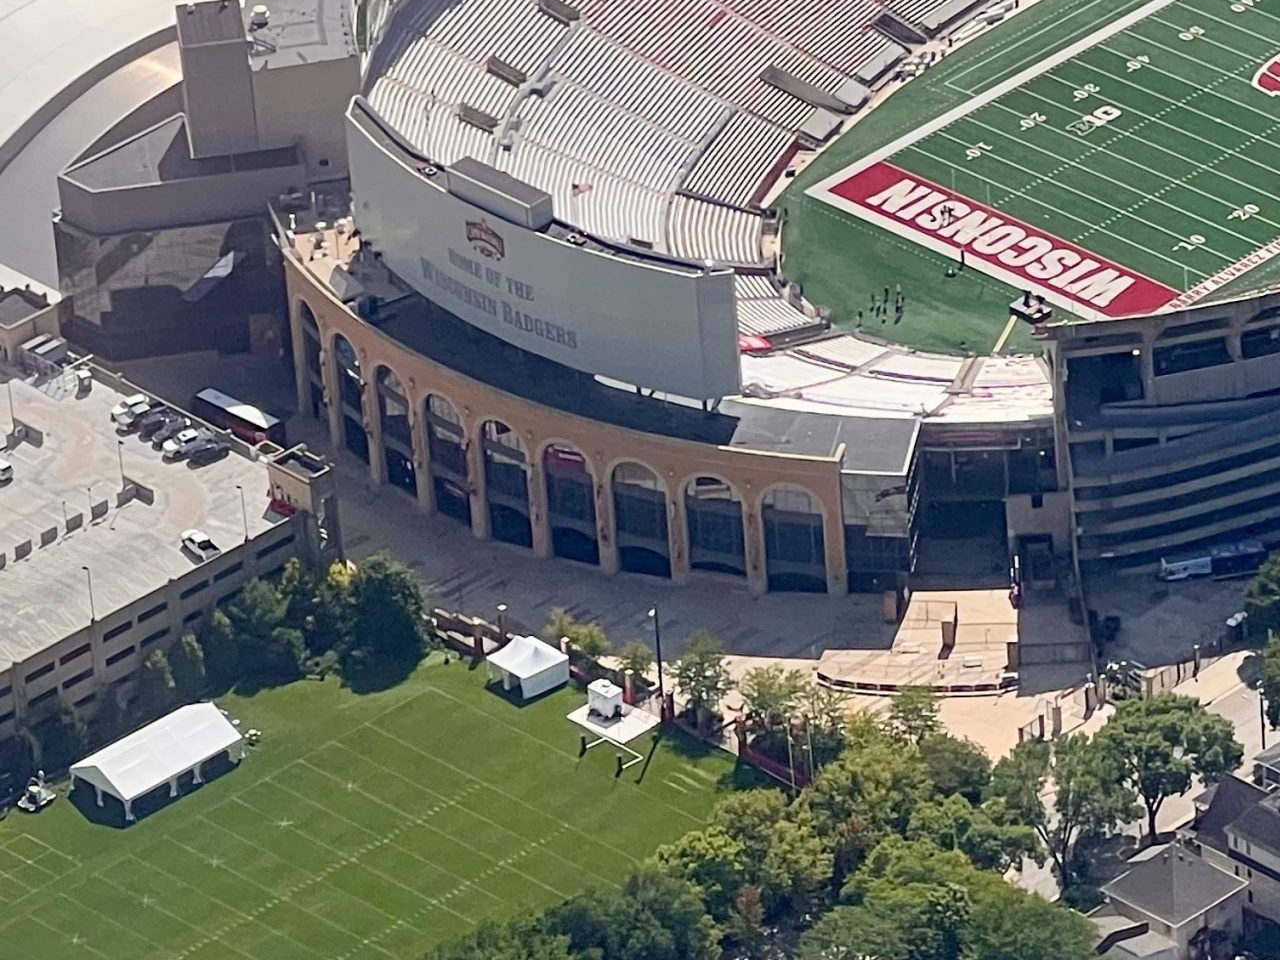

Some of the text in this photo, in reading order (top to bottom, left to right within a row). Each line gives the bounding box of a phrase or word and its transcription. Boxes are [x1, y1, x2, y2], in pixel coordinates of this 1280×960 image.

[1178, 25, 1205, 41] 50
[1075, 83, 1101, 100] 30
[1023, 112, 1047, 129] 20
[968, 141, 993, 158] 10
[1233, 204, 1260, 220] 20
[865, 178, 1136, 308] WISCONSIN
[1180, 234, 1206, 251] 10
[485, 268, 501, 289] OF
[505, 276, 535, 302] THE
[1169, 280, 1210, 310] BARRY
[1212, 253, 1265, 288] ALVAREZ
